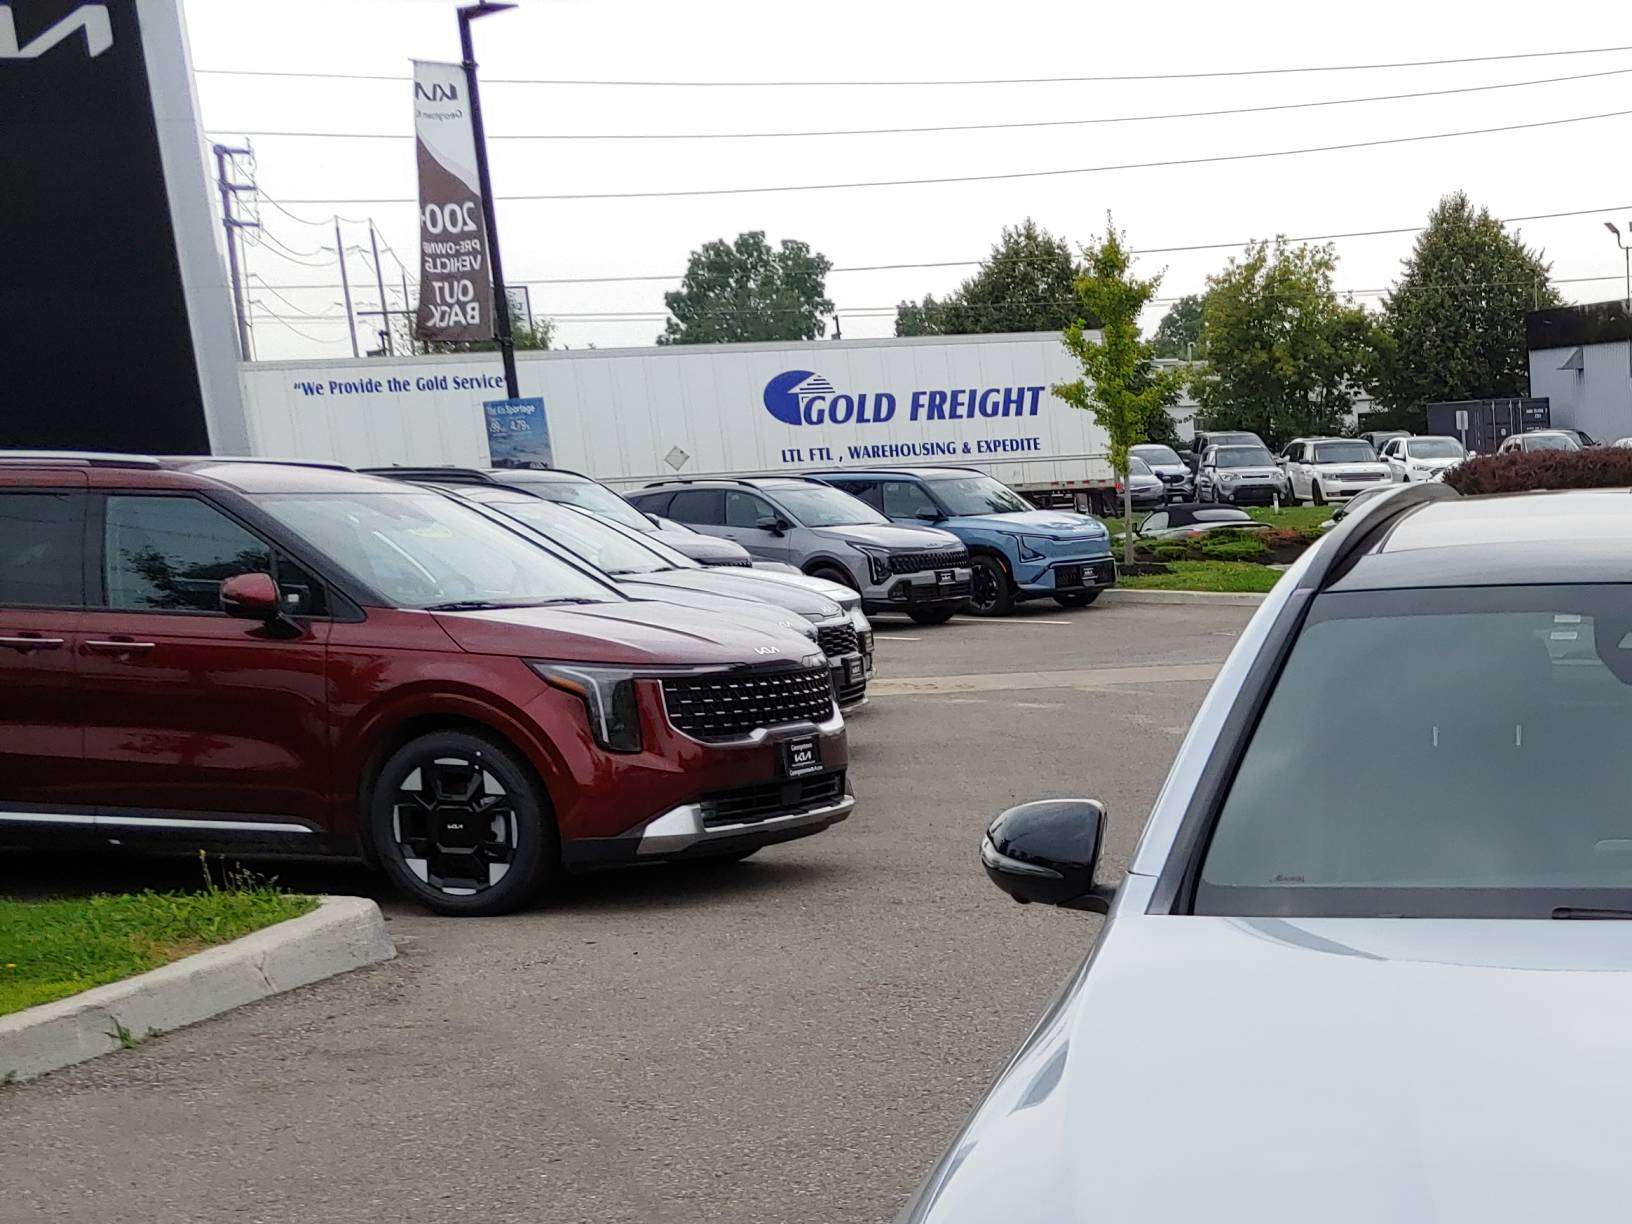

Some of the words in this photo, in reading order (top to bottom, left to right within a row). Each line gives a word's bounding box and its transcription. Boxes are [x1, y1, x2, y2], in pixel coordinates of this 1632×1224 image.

[329, 378, 383, 395] Provide
[388, 376, 411, 393] the
[416, 375, 448, 392] Gold
[803, 393, 896, 426] GOLD
[910, 386, 1045, 421] FREIGHT
[782, 448, 805, 463] LTL
[810, 446, 834, 462] FTL
[848, 441, 956, 460] WAREHOUSING
[962, 442, 971, 454] &
[977, 437, 1040, 453] EXPEDITE
[794, 751, 811, 762] KIA
